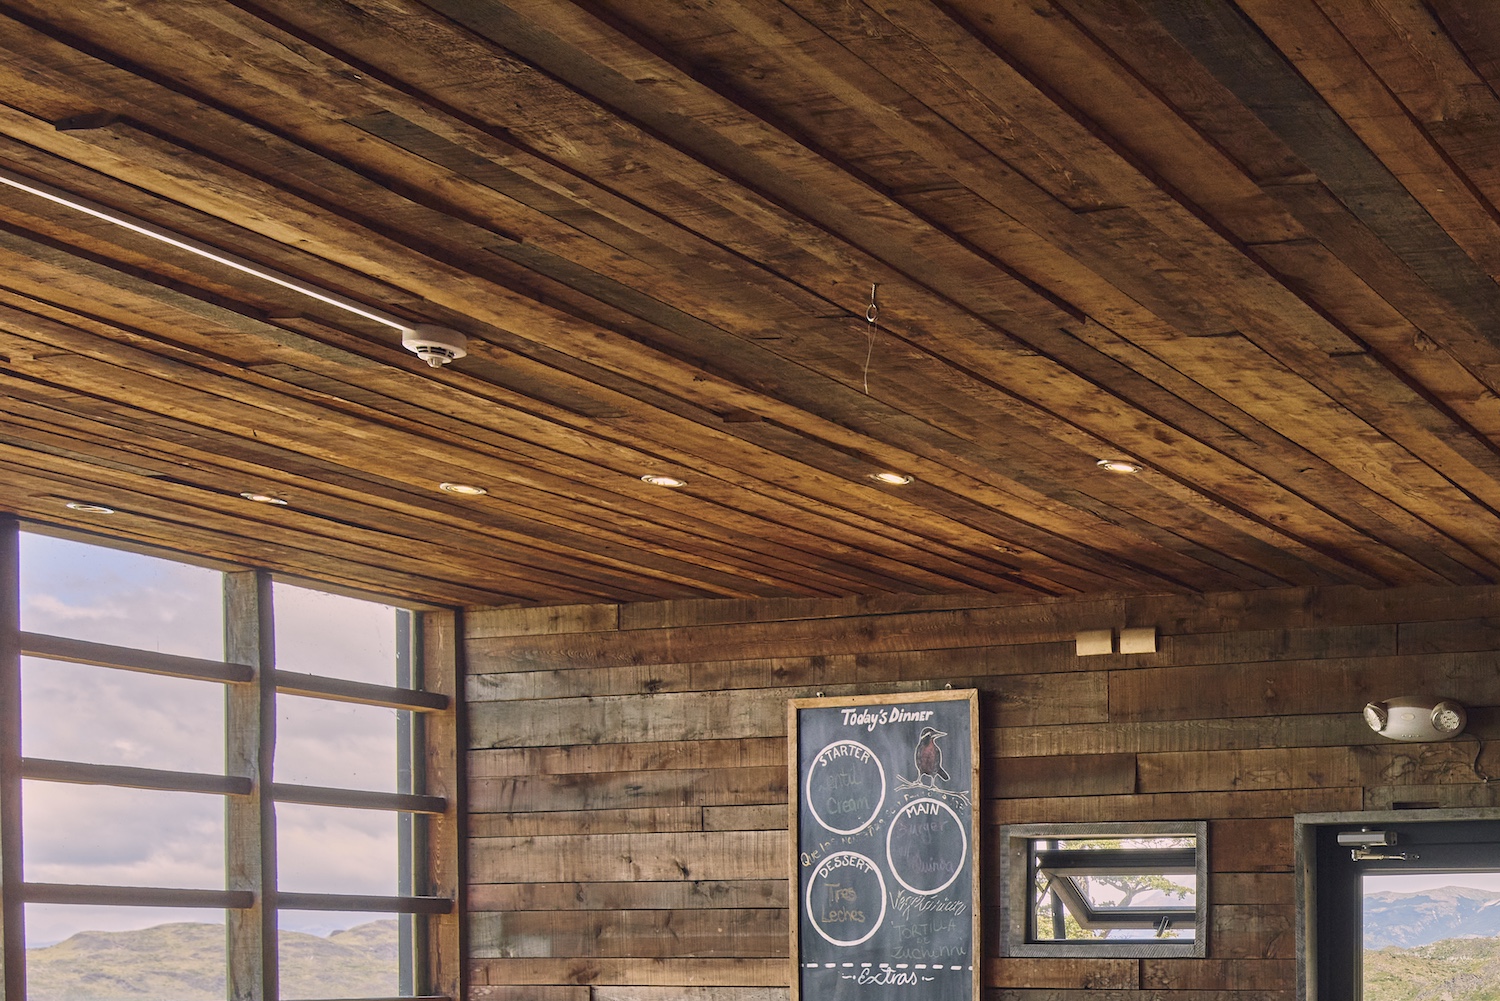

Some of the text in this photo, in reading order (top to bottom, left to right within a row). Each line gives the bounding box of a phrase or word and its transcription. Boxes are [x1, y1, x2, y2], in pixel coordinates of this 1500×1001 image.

[840, 706, 934, 732] Today's Dinner
[818, 744, 872, 767] STARTER
[827, 796, 870, 815] Cream
[905, 803, 940, 819] MAIN
[818, 854, 874, 880] DESSERT
[823, 882, 858, 906] Tres
[821, 904, 866, 923] Leches
[892, 918, 957, 942] TORTILLA
[857, 965, 918, 986] Extras
